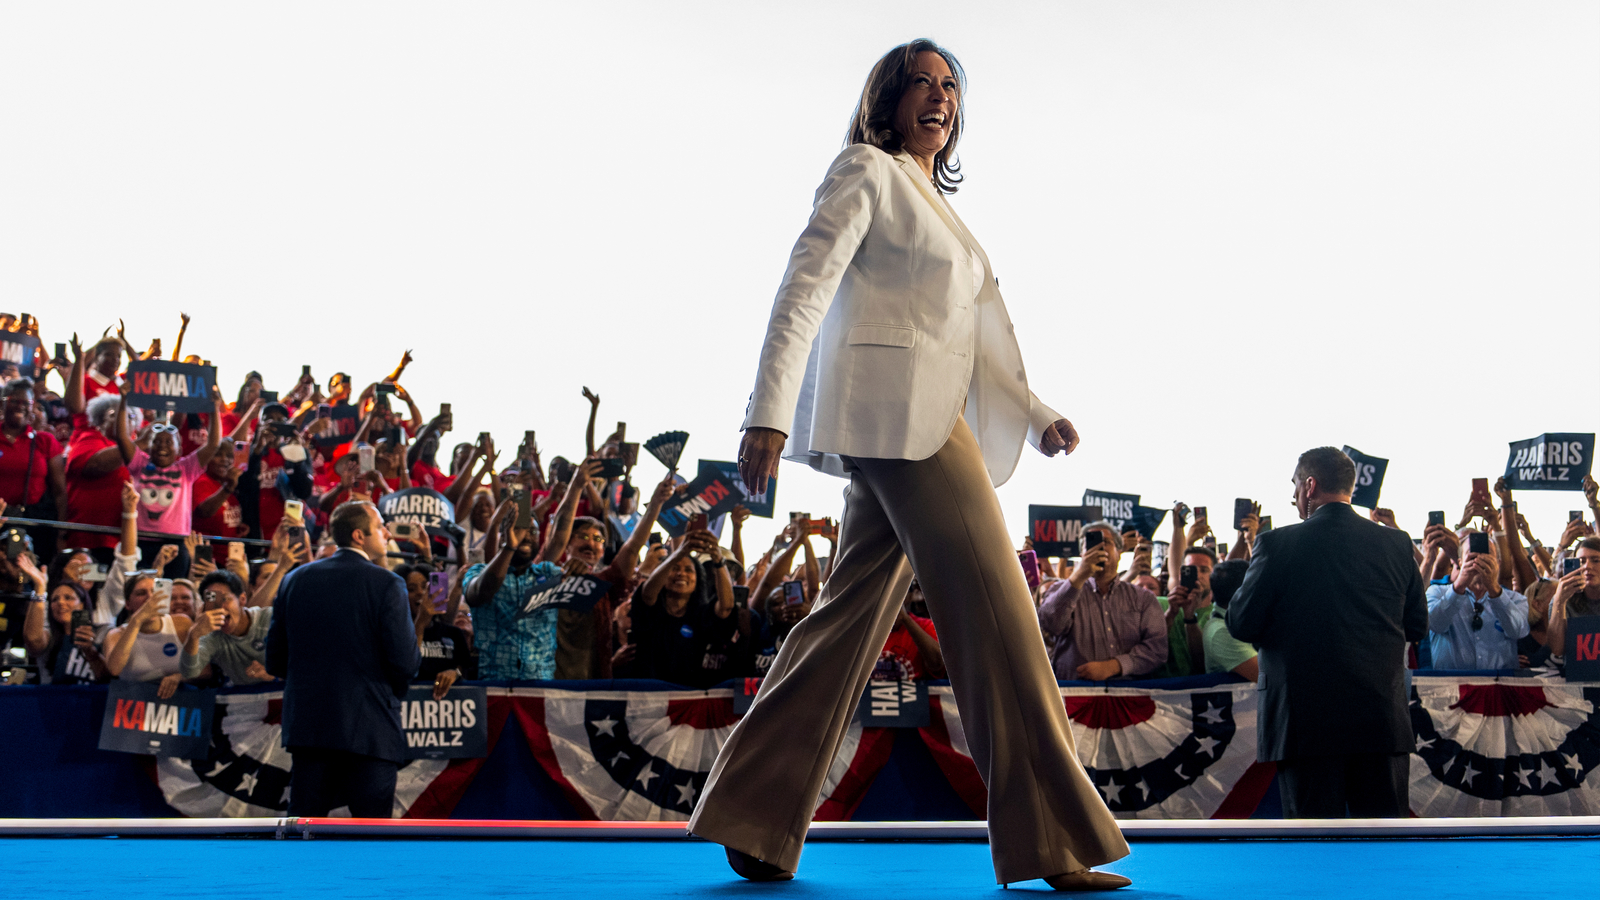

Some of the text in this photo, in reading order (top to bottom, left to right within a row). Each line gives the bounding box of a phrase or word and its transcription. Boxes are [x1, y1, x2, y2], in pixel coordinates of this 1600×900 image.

[0, 340, 33, 367] MALA
[133, 371, 207, 398] KAMALA
[1511, 442, 1583, 468] HARRIS
[1355, 461, 1376, 487] IS
[1519, 467, 1569, 481] WALZ
[384, 494, 450, 521] HARRIS
[660, 479, 730, 525] KAMALA
[1034, 519, 1088, 543] KAMA
[744, 677, 763, 695] K
[112, 698, 202, 737] KAMALA
[400, 699, 477, 729] HARRIS
[406, 730, 464, 748] WALZ
